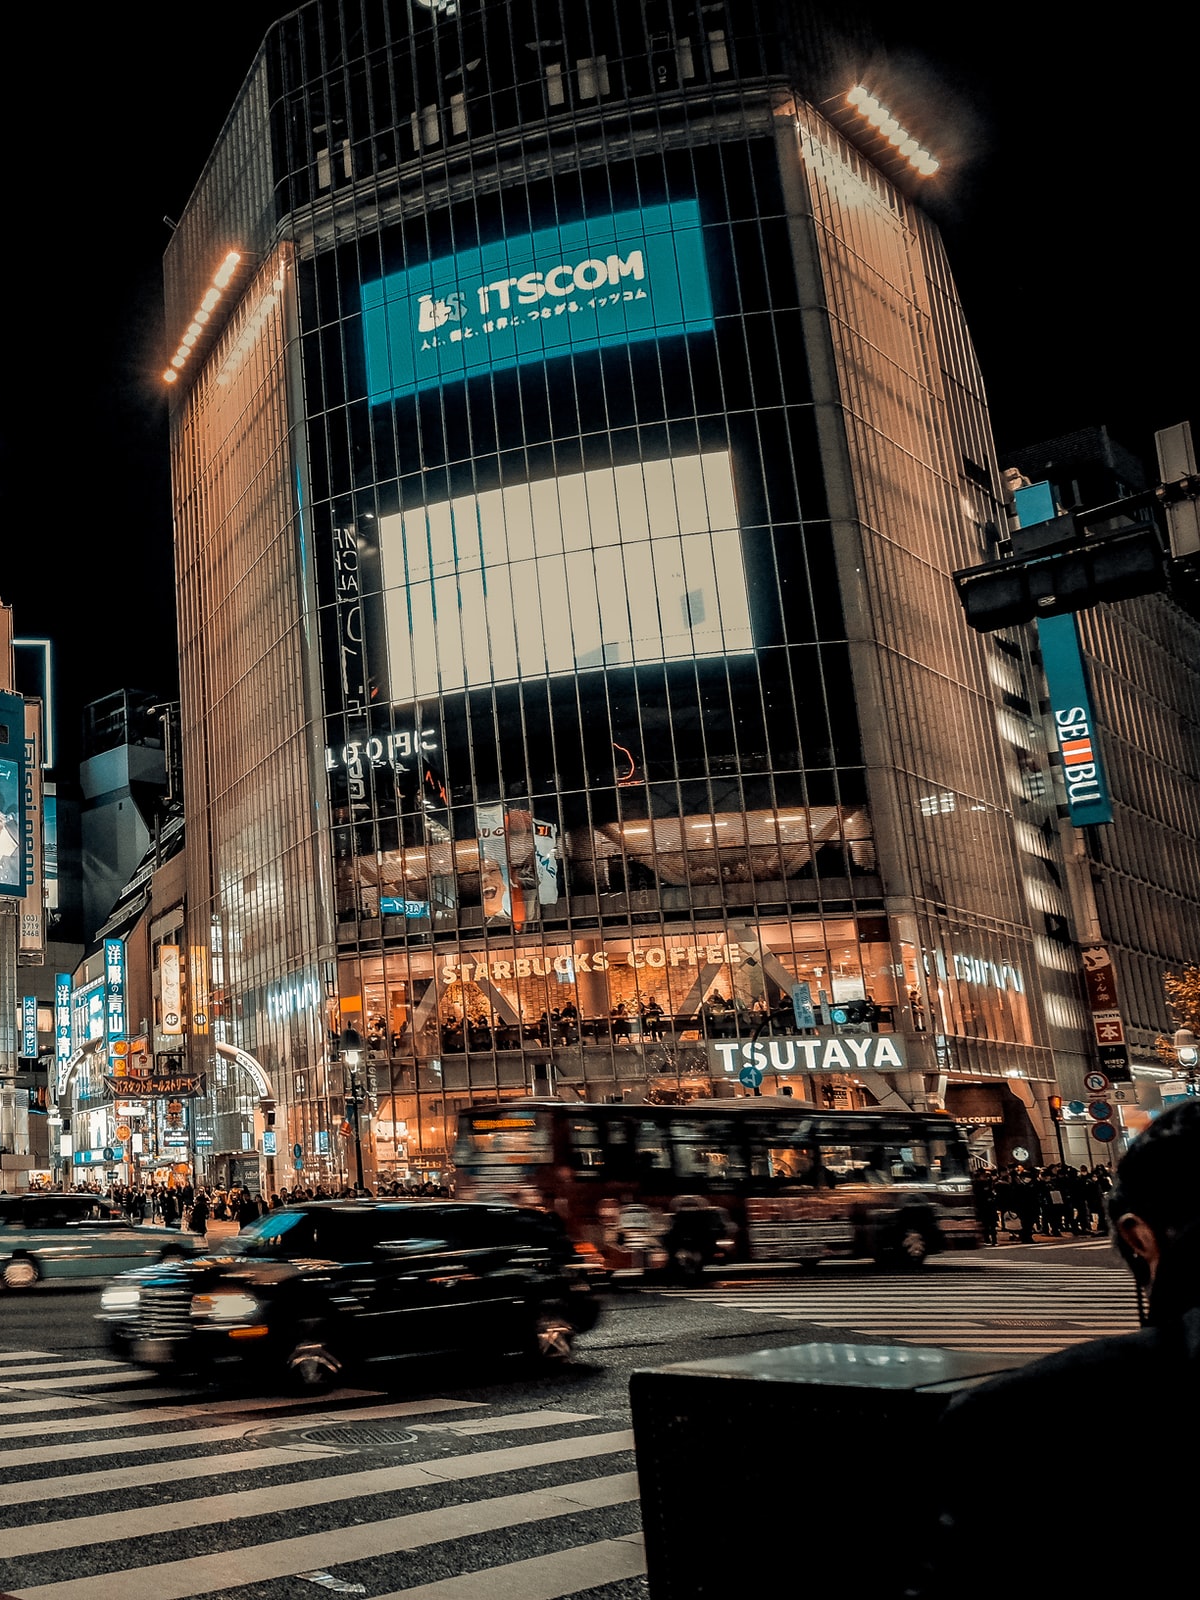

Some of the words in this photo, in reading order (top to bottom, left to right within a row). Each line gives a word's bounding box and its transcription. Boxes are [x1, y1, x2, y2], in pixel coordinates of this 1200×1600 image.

[441, 951, 610, 985] STARBUCKS
[627, 943, 742, 969] COFFEE
[107, 945, 124, 1033] 洋服の青山
[1099, 1024, 1119, 1041] 本
[714, 1037, 902, 1071] TSUTAYA
[968, 1116, 1003, 1124] COFFEE
